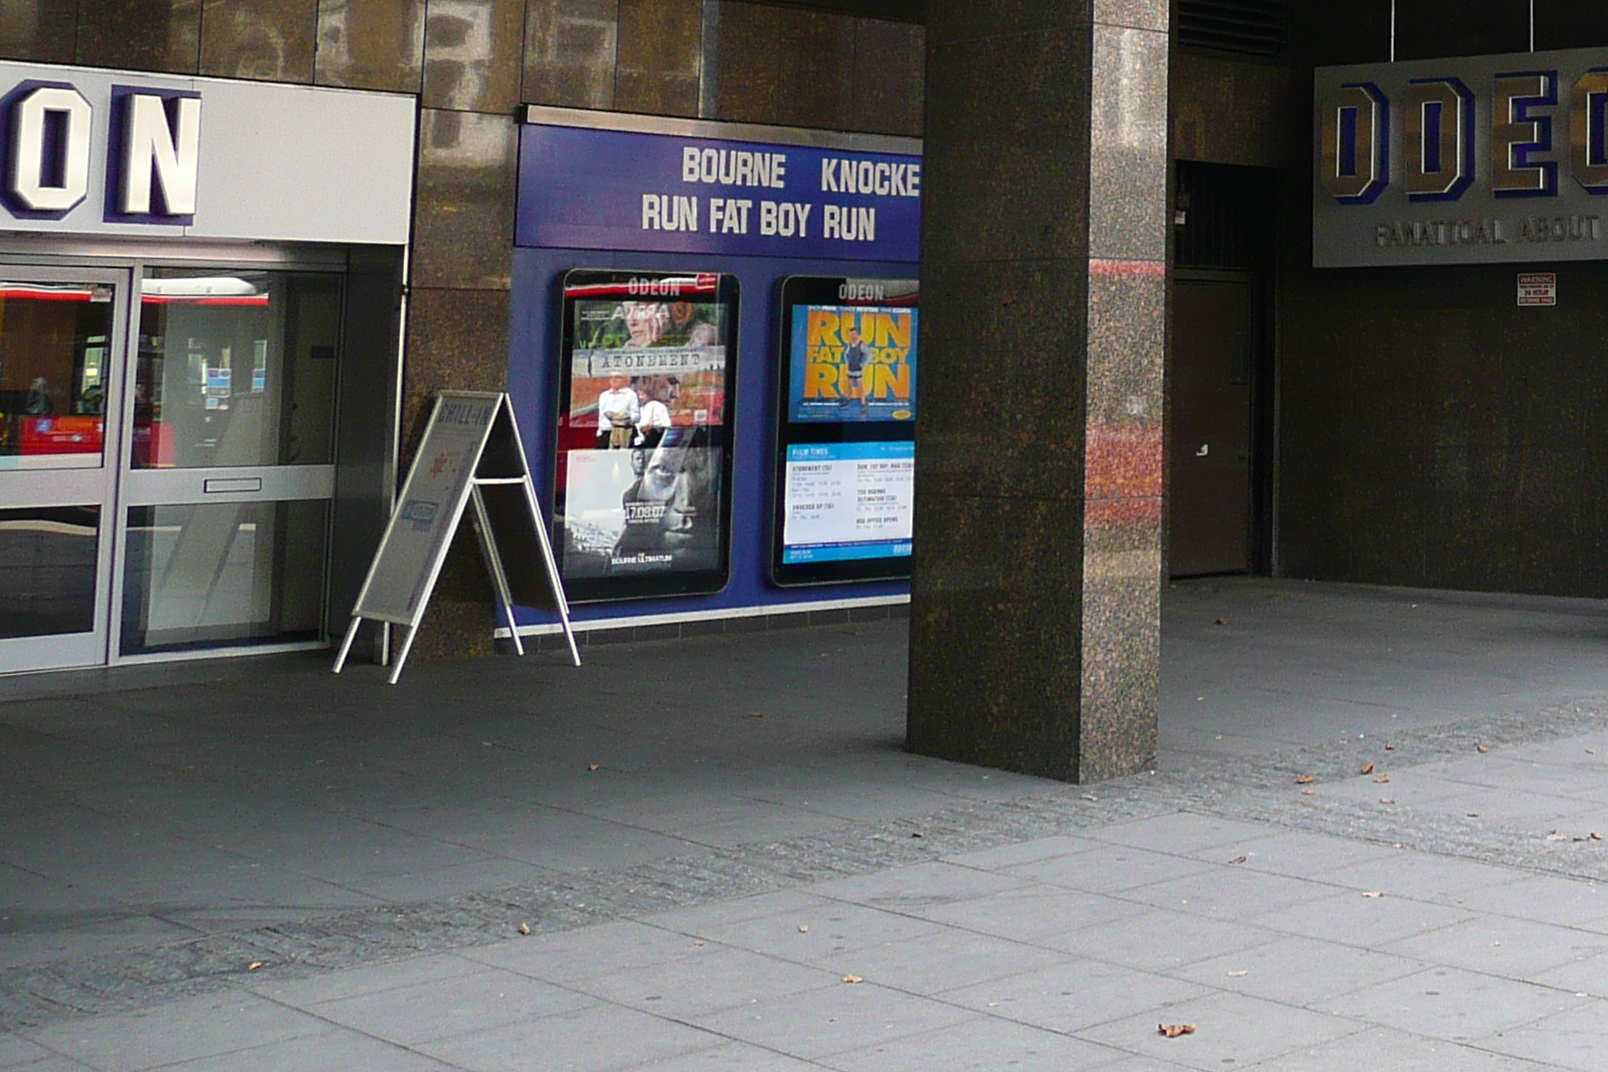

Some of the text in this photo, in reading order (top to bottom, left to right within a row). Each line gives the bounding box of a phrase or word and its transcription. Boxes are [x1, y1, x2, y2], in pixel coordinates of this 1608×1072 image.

[682, 146, 920, 197] BOURNE KNOCKE
[642, 194, 876, 241] RUN FAT BOY RUN
[1377, 219, 1507, 247] FANATICAL
[1519, 215, 1599, 243] ABOUT
[628, 277, 681, 296] ODEON
[838, 284, 885, 301] ODEON
[807, 311, 911, 347] RUN
[602, 353, 700, 368] ATONEMENT
[806, 346, 910, 364] FAT BOY
[804, 363, 910, 398] RUN
